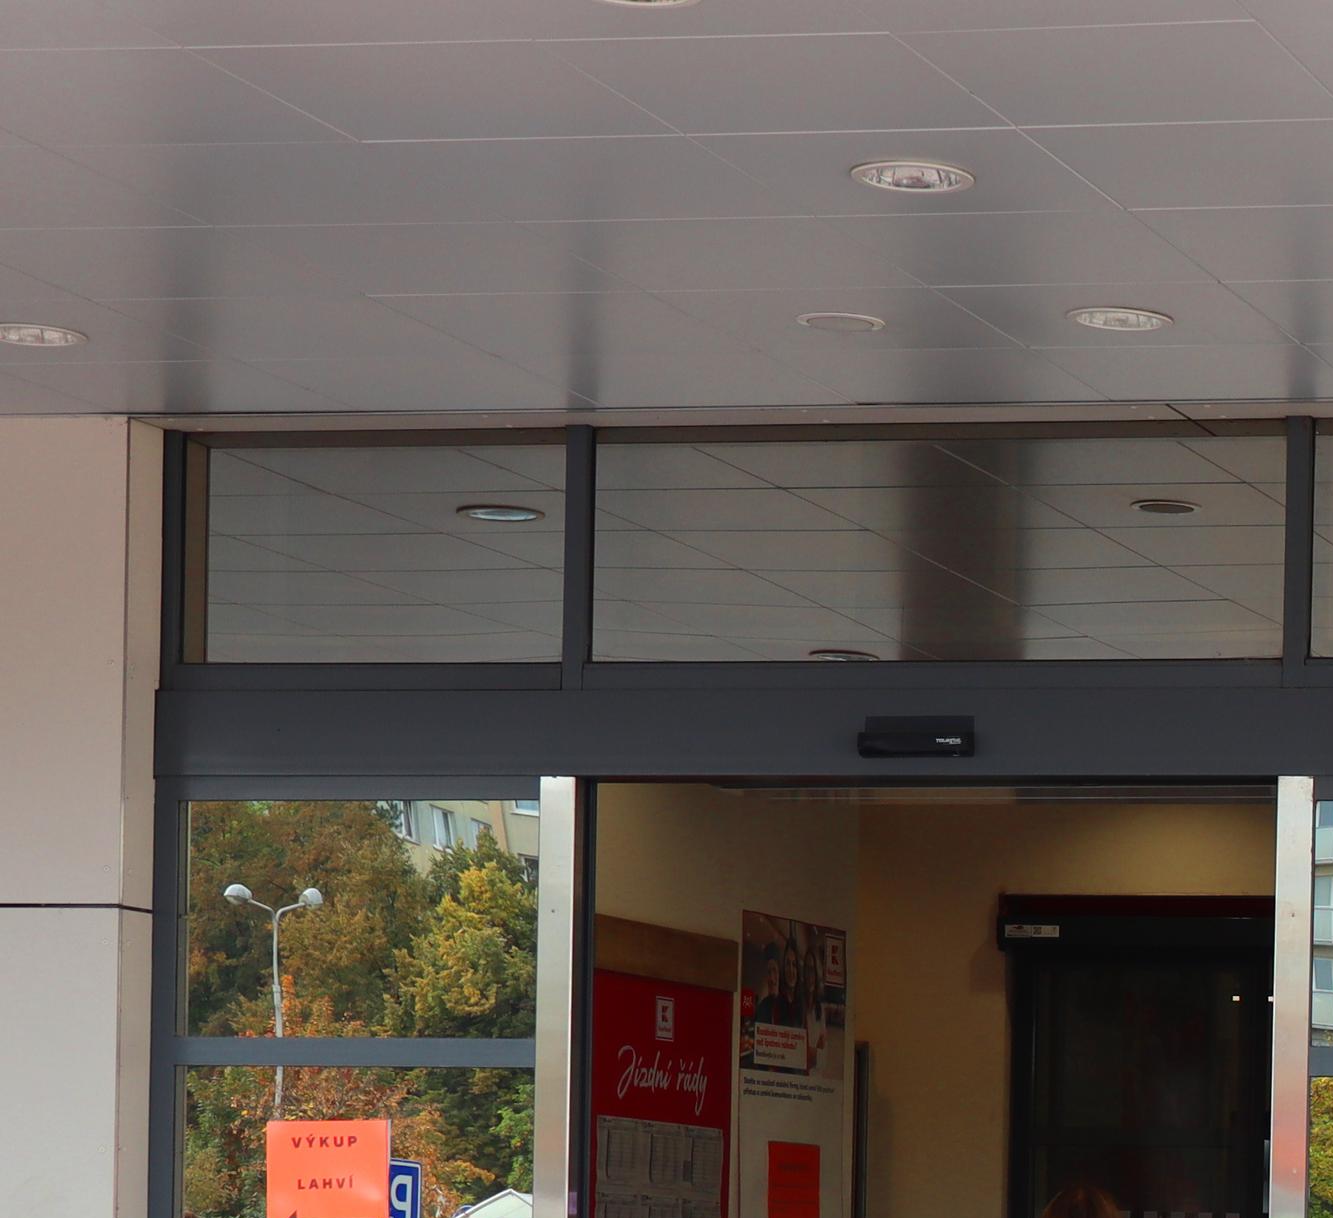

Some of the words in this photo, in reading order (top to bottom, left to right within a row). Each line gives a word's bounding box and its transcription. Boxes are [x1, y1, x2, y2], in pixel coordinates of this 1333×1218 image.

[618, 1045, 673, 1099] Jízdní
[677, 1057, 708, 1116] řády
[291, 1134, 358, 1148] VÝKUP
[297, 1174, 354, 1189] LAHVÍ
